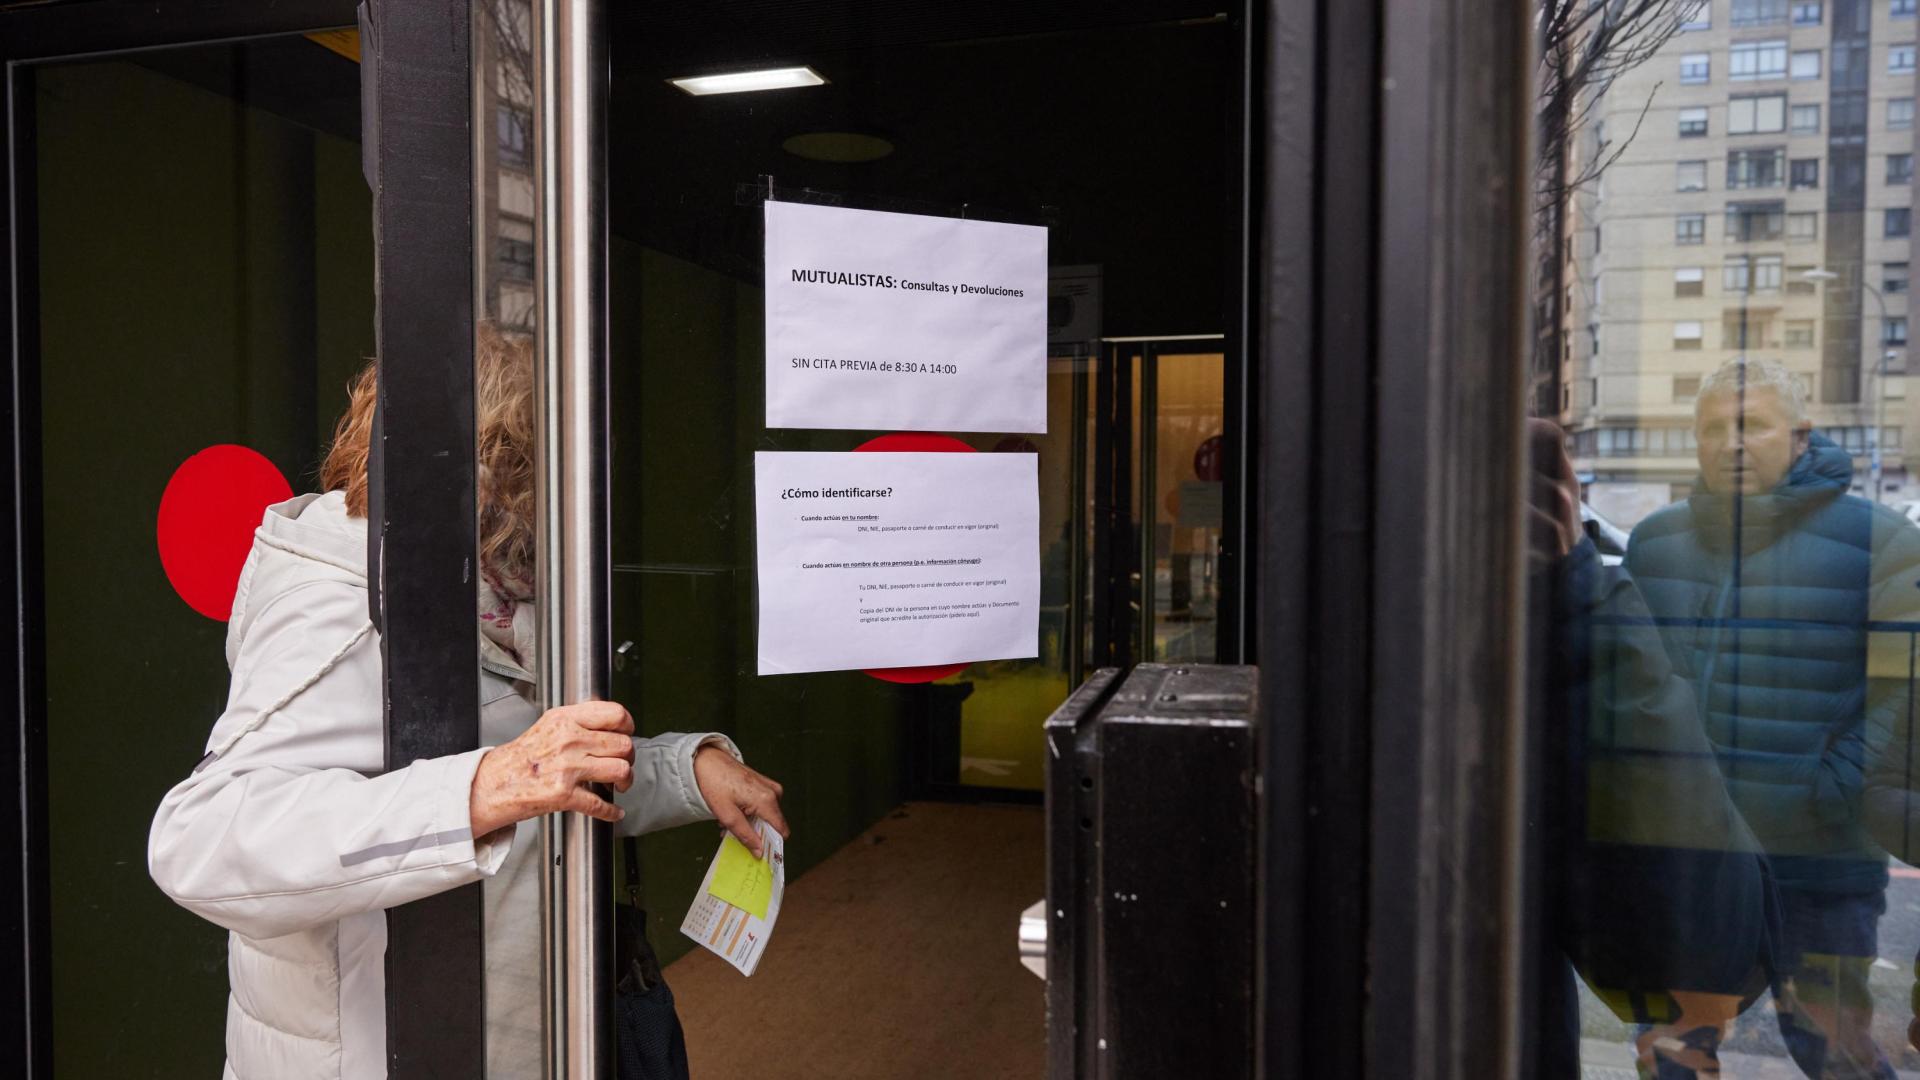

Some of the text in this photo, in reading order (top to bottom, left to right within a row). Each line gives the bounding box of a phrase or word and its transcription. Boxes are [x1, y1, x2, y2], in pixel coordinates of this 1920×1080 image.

[792, 269, 1024, 298] MUTUALISTAS: Consultas y Devoluciones
[792, 358, 957, 375] SIN CITA PREVIA de 8:30 A 14:00
[781, 487, 893, 500] ¿Cómo identificarse?
